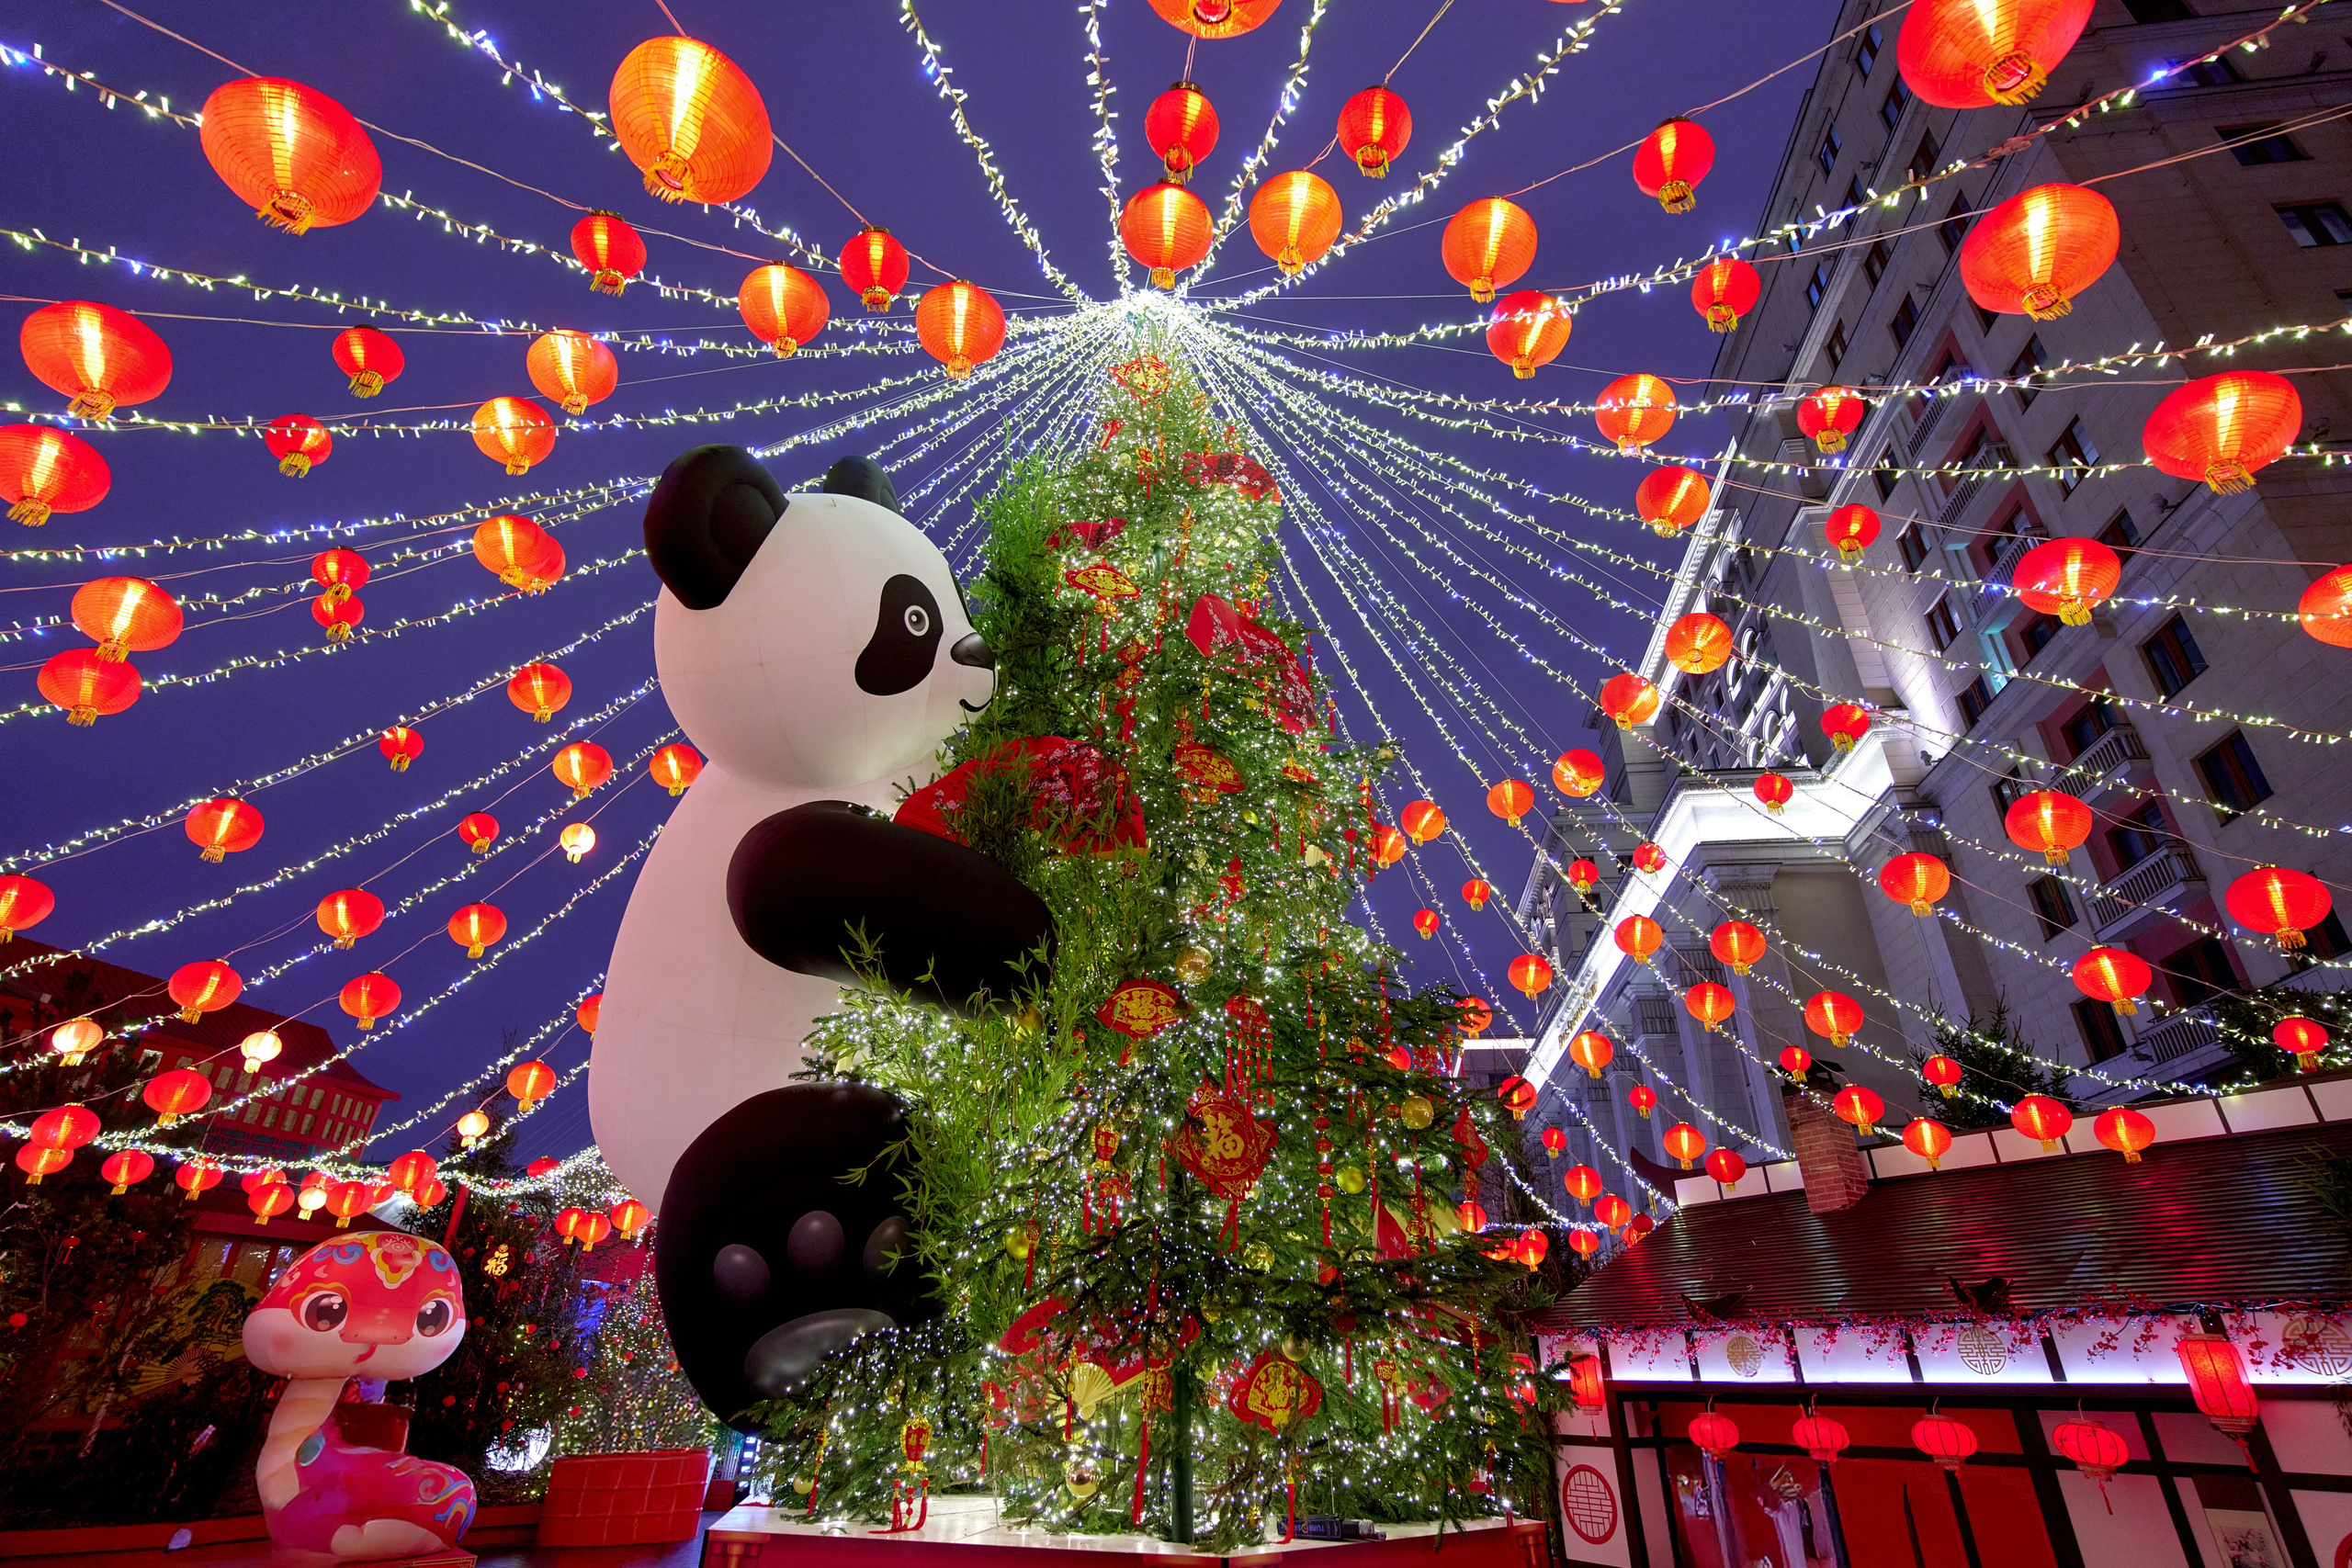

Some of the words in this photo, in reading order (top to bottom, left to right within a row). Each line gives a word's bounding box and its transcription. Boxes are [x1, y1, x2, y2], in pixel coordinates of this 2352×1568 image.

[1126, 990, 1157, 1019] 福
[1243, 1001, 1260, 1017] 福
[1201, 1111, 1246, 1160] 福
[483, 1250, 509, 1276] 福
[1266, 1366, 1289, 1408] 福
[1294, 1523, 1325, 1534] TURBOSK
